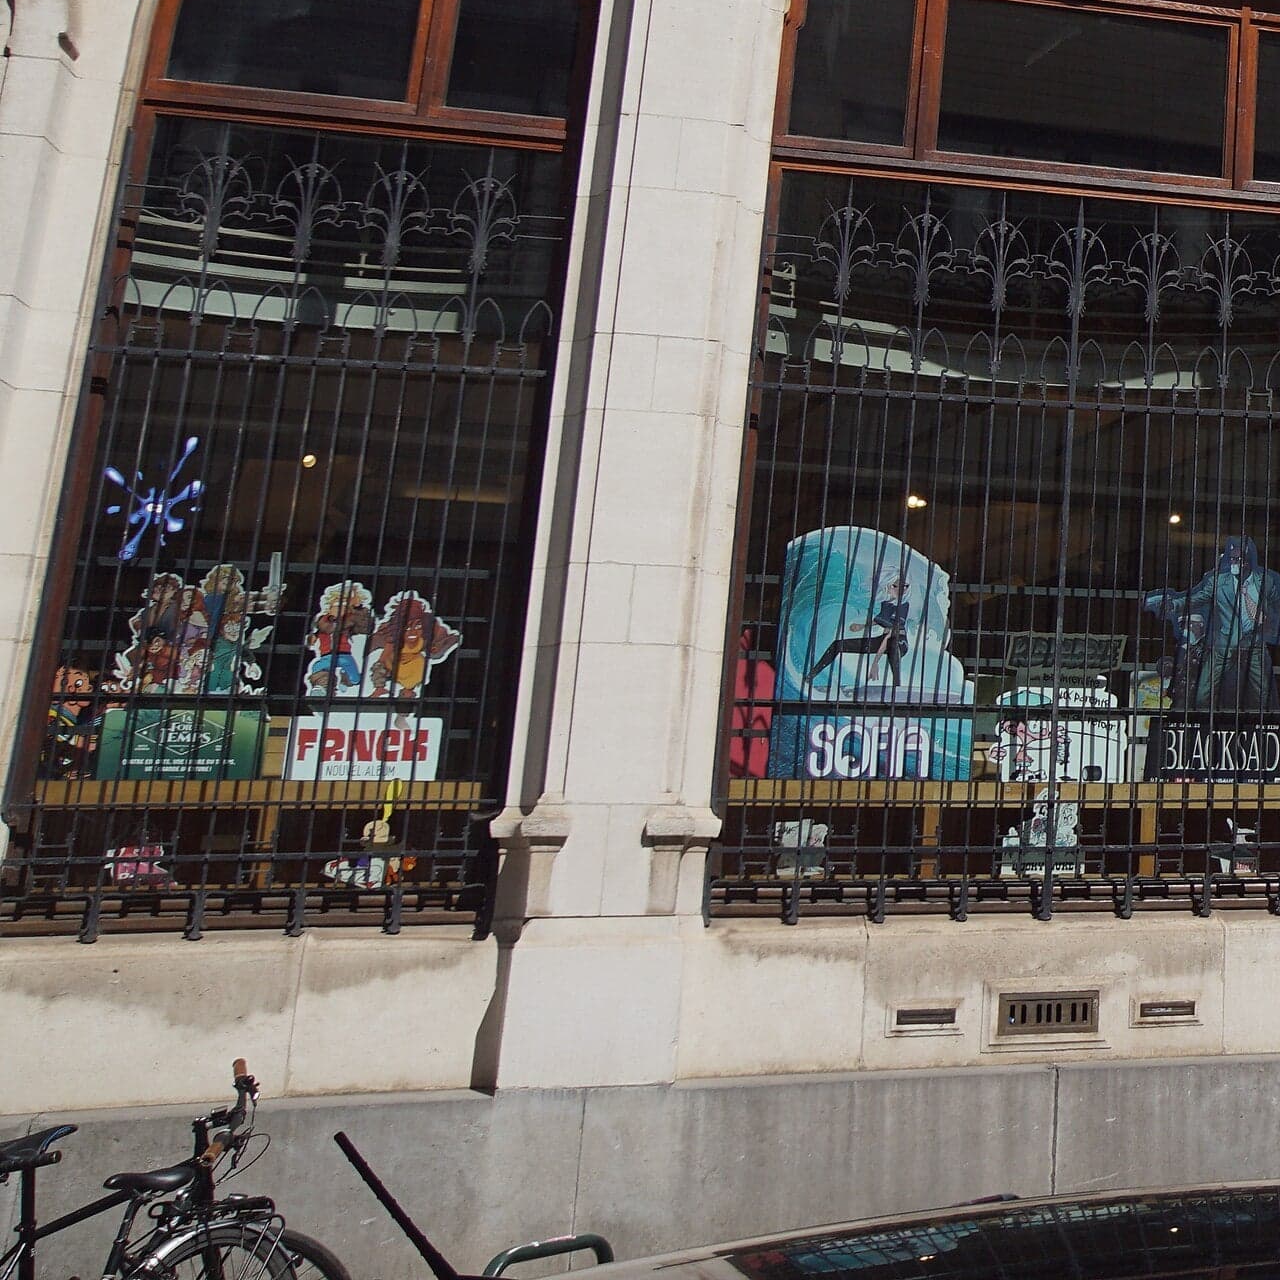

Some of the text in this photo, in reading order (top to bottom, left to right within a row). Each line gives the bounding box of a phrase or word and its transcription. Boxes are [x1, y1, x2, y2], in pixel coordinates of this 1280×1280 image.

[297, 728, 429, 762] FRNCK
[808, 723, 931, 777] SOFIA
[1161, 729, 1280, 772] BLACKSAD
